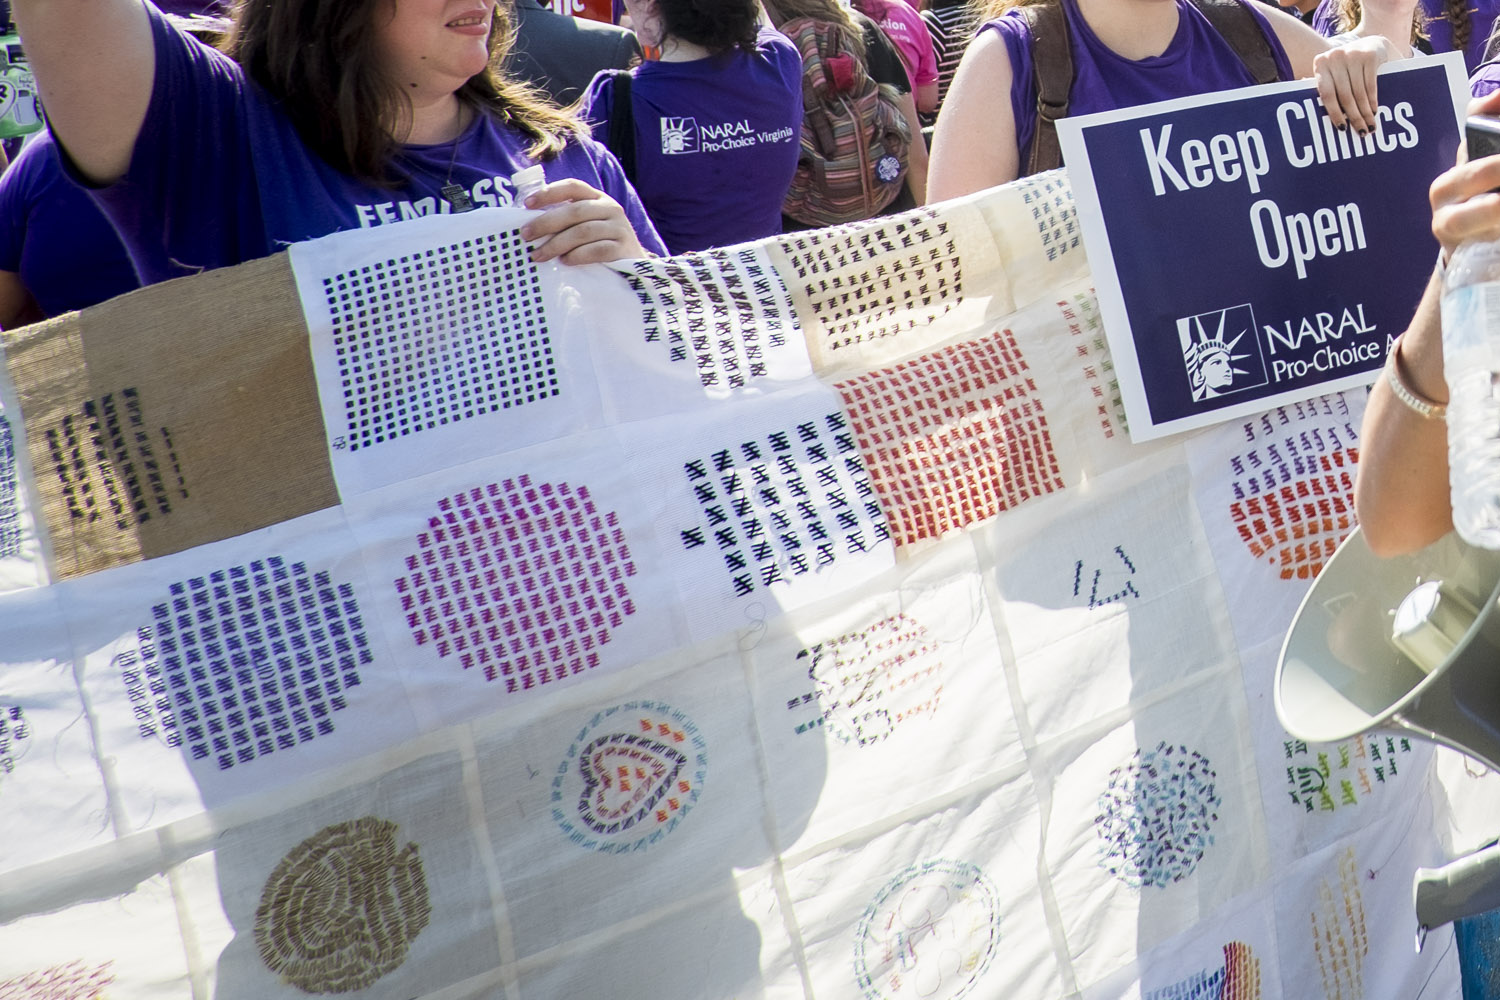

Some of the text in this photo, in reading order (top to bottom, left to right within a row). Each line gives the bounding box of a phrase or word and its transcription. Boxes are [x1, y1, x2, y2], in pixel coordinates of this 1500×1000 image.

[701, 120, 755, 141] NARAL
[702, 127, 794, 152] Pro-Choice Virginia
[1140, 124, 1270, 196] Keep
[1249, 199, 1367, 279] Open
[1263, 303, 1377, 355] NARAL
[1272, 341, 1380, 382] Pro-Choice
